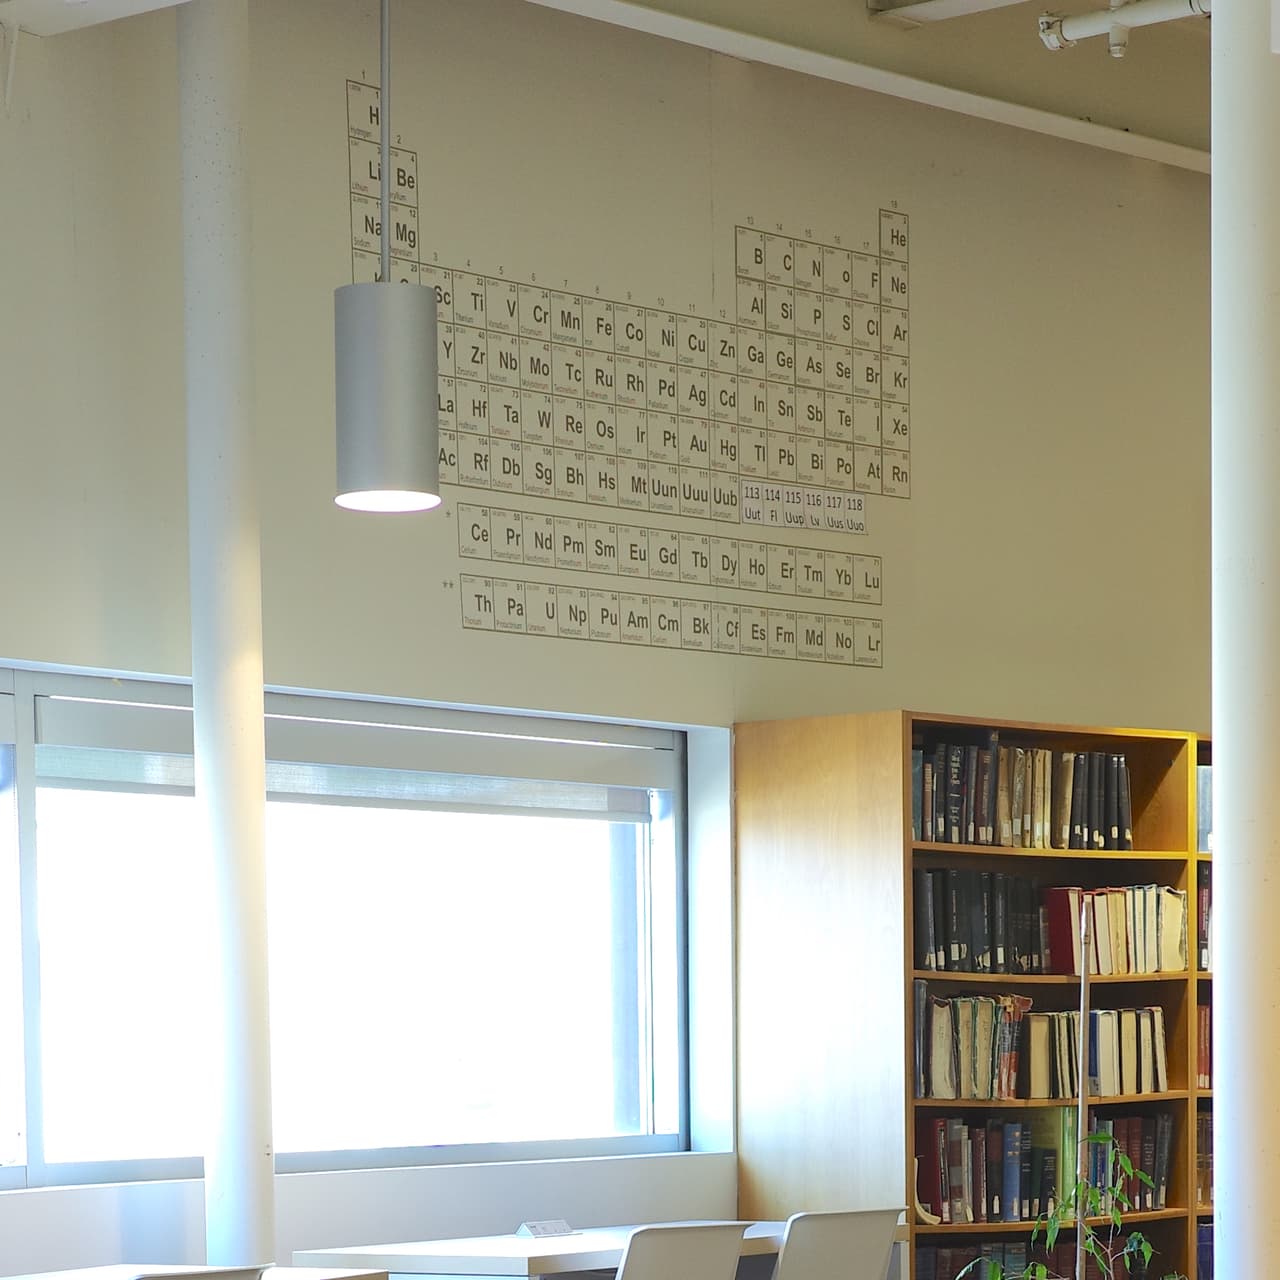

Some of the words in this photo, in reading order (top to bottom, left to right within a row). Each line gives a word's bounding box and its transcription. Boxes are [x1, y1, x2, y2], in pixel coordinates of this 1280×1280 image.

[369, 105, 379, 126] H
[369, 160, 381, 181] Li
[397, 168, 415, 189] Be
[364, 215, 381, 236] Na
[396, 222, 416, 249] Mg
[891, 228, 906, 247] He
[754, 248, 763, 264] B
[783, 254, 792, 271] C
[812, 260, 821, 277] N
[871, 272, 878, 288] F
[891, 276, 906, 294] Ne
[471, 292, 483, 312] Ti
[506, 299, 516, 318] V
[533, 305, 549, 324] Cr
[561, 310, 580, 331] Mn
[596, 317, 612, 336] Fe
[625, 322, 643, 342] Co
[662, 329, 675, 347] Ni
[688, 334, 705, 352] Cu
[720, 339, 735, 358] Zn
[747, 345, 764, 364] Ga
[776, 351, 793, 369] Ge
[806, 356, 823, 374] As
[836, 361, 851, 379] Se
[866, 366, 880, 384] Br
[894, 371, 907, 389] Kr
[751, 297, 763, 315] Al
[781, 302, 792, 320] Si
[814, 309, 821, 325] P
[842, 315, 851, 331] S
[867, 319, 879, 336] Cl
[893, 325, 907, 341] Ar
[443, 340, 452, 359] Y
[471, 346, 486, 365] Zr
[499, 351, 518, 371] Nb
[530, 356, 550, 376] Mo
[565, 363, 582, 382] Tc
[595, 368, 613, 388] Ru
[626, 373, 644, 393] Rh
[659, 379, 675, 398] Pd
[688, 384, 706, 407] Ag
[719, 390, 736, 408] Cd
[754, 395, 765, 413] In
[778, 400, 794, 418] Sn
[807, 404, 823, 422] Sb
[837, 409, 851, 427] Te
[893, 418, 908, 436] Xe
[438, 393, 454, 413] La
[472, 399, 487, 418] Hf
[503, 404, 519, 424] Ta
[537, 410, 551, 429] W
[566, 415, 583, 434] Re
[596, 420, 614, 439] Os
[636, 426, 646, 443] Ir
[663, 430, 677, 449] Pt
[690, 434, 707, 453] Au
[720, 439, 736, 462] Hg
[754, 444, 765, 462] Tl
[779, 448, 795, 466] Pb
[811, 453, 823, 470] Bi
[837, 457, 852, 475] Po
[867, 462, 880, 479] At
[892, 465, 908, 483] Rn
[438, 448, 456, 466] Ac
[474, 452, 489, 472] Rf
[502, 457, 520, 476] Db
[535, 462, 552, 485] Sg
[566, 466, 584, 486] Bh
[598, 471, 616, 490] Hs
[631, 476, 647, 495] Mt
[652, 478, 677, 499] Uun
[683, 483, 708, 502] Uuu
[713, 487, 738, 507] Uub
[745, 486, 760, 500] 113
[765, 488, 780, 502] 114
[785, 491, 802, 504] 115
[806, 493, 822, 507] 116
[827, 496, 842, 509] 117
[847, 498, 862, 511] 118
[745, 507, 761, 520] Uut
[785, 512, 804, 526] Uup
[827, 516, 844, 529] Uus
[846, 518, 865, 532] Uuo
[471, 523, 489, 542] Ce
[506, 528, 521, 546] Pr
[534, 531, 552, 550] Nd
[563, 535, 584, 554] Pm
[595, 539, 615, 558] Sm
[630, 543, 646, 561] Eu
[659, 547, 677, 565] Gd
[691, 551, 708, 569] Tb
[722, 554, 737, 577] Dy
[749, 558, 765, 576] Ho
[781, 562, 794, 579] Er
[804, 565, 823, 582] Tm
[836, 568, 851, 586] Yb
[865, 572, 879, 589] Lu
[474, 594, 492, 613] Th
[507, 598, 524, 616] Pa
[546, 602, 555, 619] U
[569, 604, 587, 627] Np
[601, 608, 618, 626] Pu
[627, 611, 649, 629] Am
[658, 614, 679, 632] Cm
[693, 617, 709, 635] Bk
[726, 620, 739, 638] Cf
[751, 624, 766, 640] Es
[776, 626, 794, 644] Fm
[806, 629, 823, 646] Md
[836, 632, 852, 649] No
[868, 635, 880, 651] Lr
